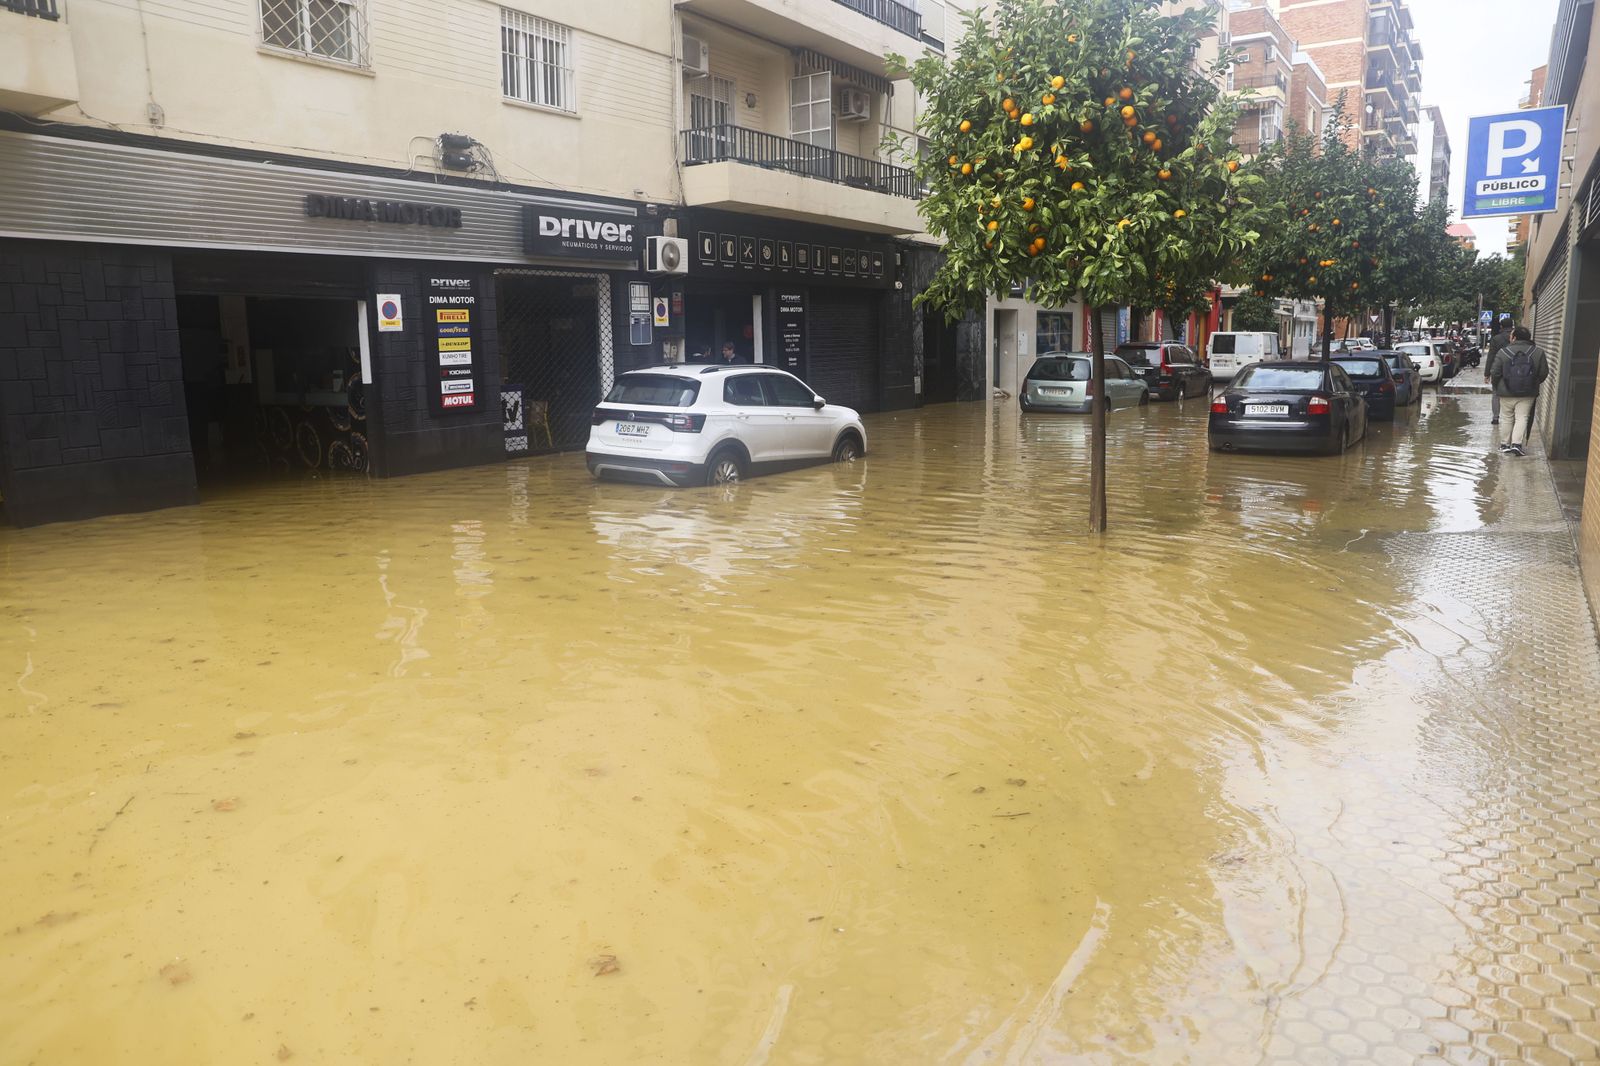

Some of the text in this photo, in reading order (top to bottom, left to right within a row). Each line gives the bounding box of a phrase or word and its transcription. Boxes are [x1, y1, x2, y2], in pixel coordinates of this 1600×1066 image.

[1486, 120, 1542, 177] P
[1482, 179, 1540, 192] PÚBLICO
[1491, 196, 1526, 206] LIBRE
[306, 193, 463, 229] DIMA MOTOR
[561, 240, 599, 250] NEUMÁTICOS
[604, 243, 633, 252] SERVICIOS
[429, 296, 475, 304] DIMA MOTOR
[439, 311, 467, 320] PIRELLI
[439, 326, 469, 334] GOODYEAR
[444, 395, 473, 406] MOTUL
[1251, 405, 1285, 413] 5102 BVM
[619, 424, 635, 433] 2067
